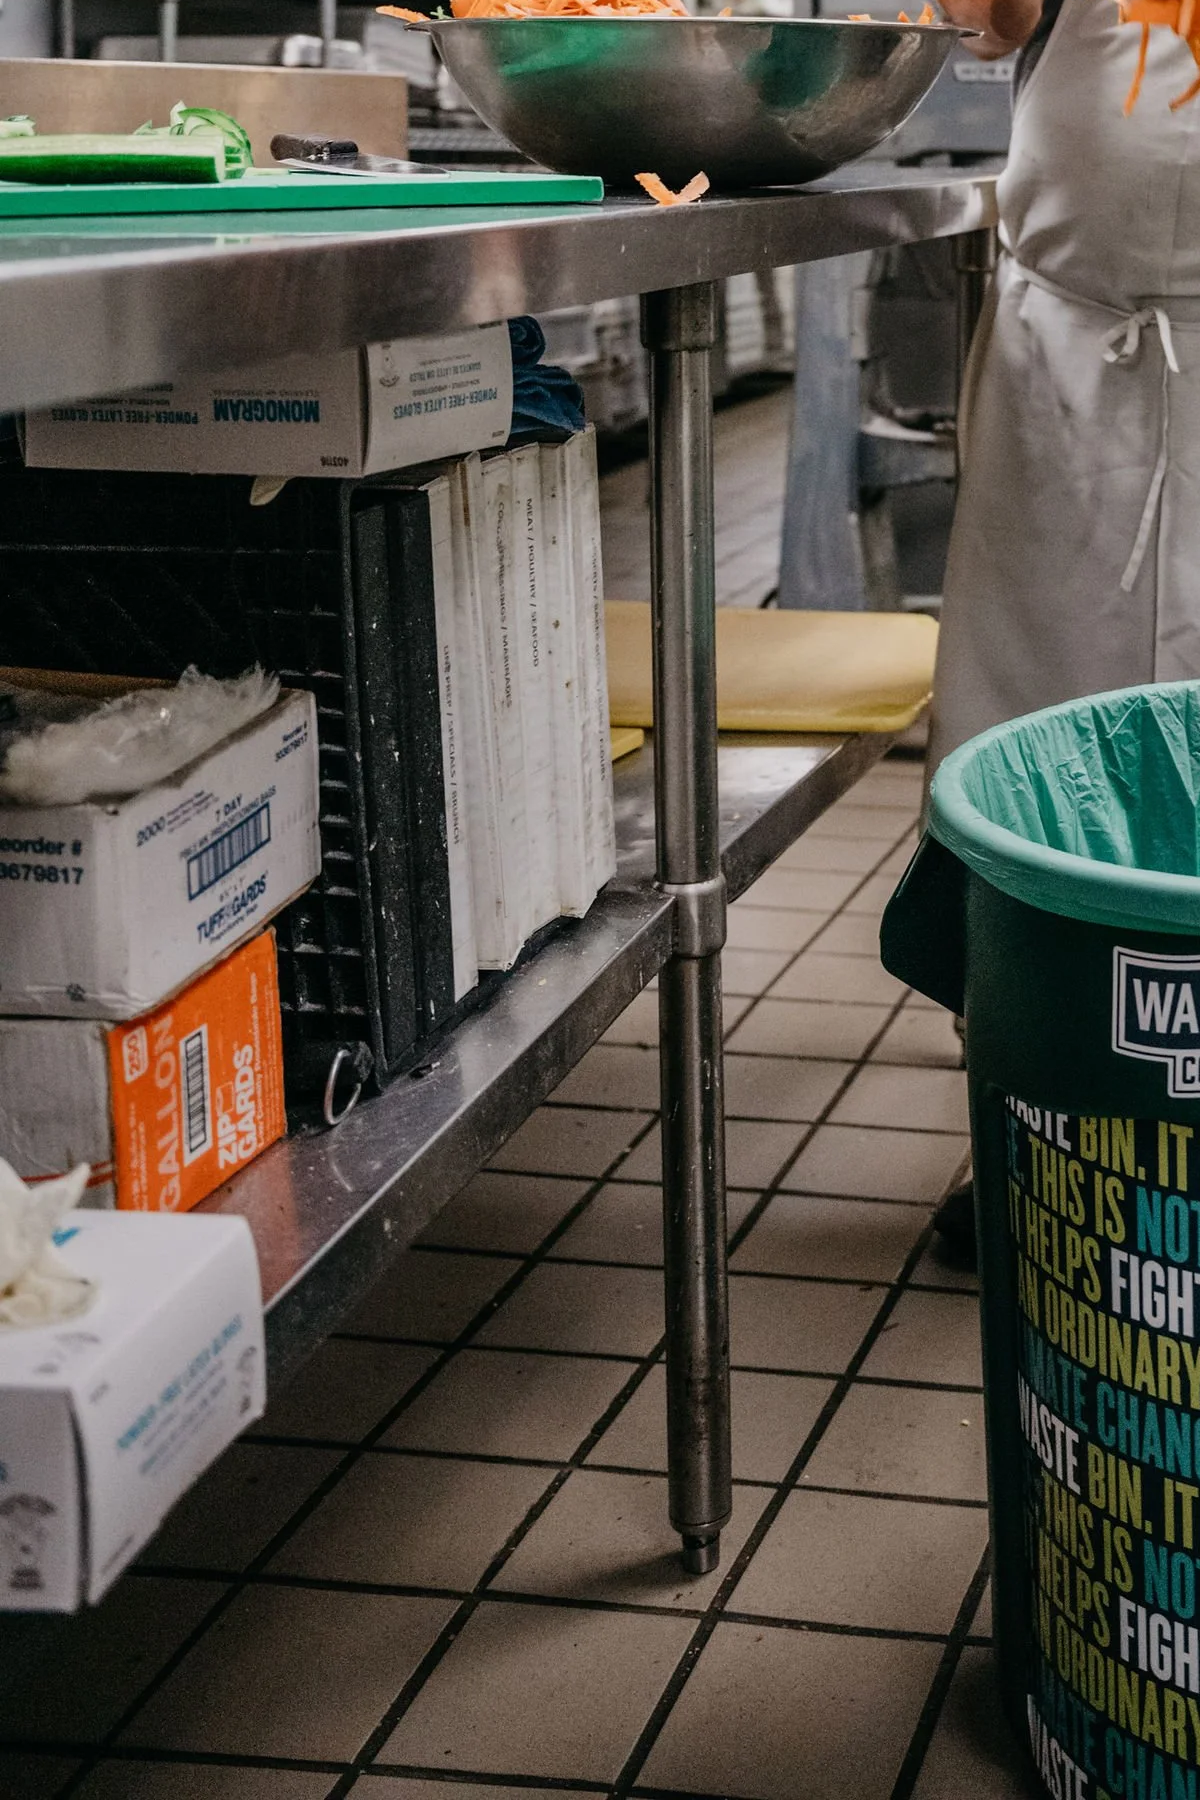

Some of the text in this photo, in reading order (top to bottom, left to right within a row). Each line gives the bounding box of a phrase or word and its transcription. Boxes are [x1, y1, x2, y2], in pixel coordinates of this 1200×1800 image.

[51, 408, 198, 425] POWDER-FREE LATEX GLOVES
[213, 399, 320, 424] MONOGRAM
[392, 388, 498, 420] POWDER-FREE LATEX GLOVES
[526, 498, 534, 532] MEAT
[528, 545, 536, 599] POULTRY
[531, 611, 539, 668] SEAFOOD
[152, 1014, 182, 1213] GALLON
[232, 1044, 257, 1160] GARDS
[216, 1112, 239, 1170] ZIP
[1079, 1116, 1146, 1181] BIN.
[1158, 1120, 1194, 1192] IT
[1027, 1132, 1086, 1227] THIS
[1094, 1170, 1127, 1245] IS
[1024, 1193, 1102, 1304] HELPS
[1018, 1368, 1081, 1496] WASTE
[1087, 1441, 1154, 1535] BIN.
[1163, 1477, 1200, 1548] IT
[1041, 1466, 1096, 1570] THIS
[1103, 1518, 1134, 1594] IS
[1038, 1526, 1112, 1648] HELPS
